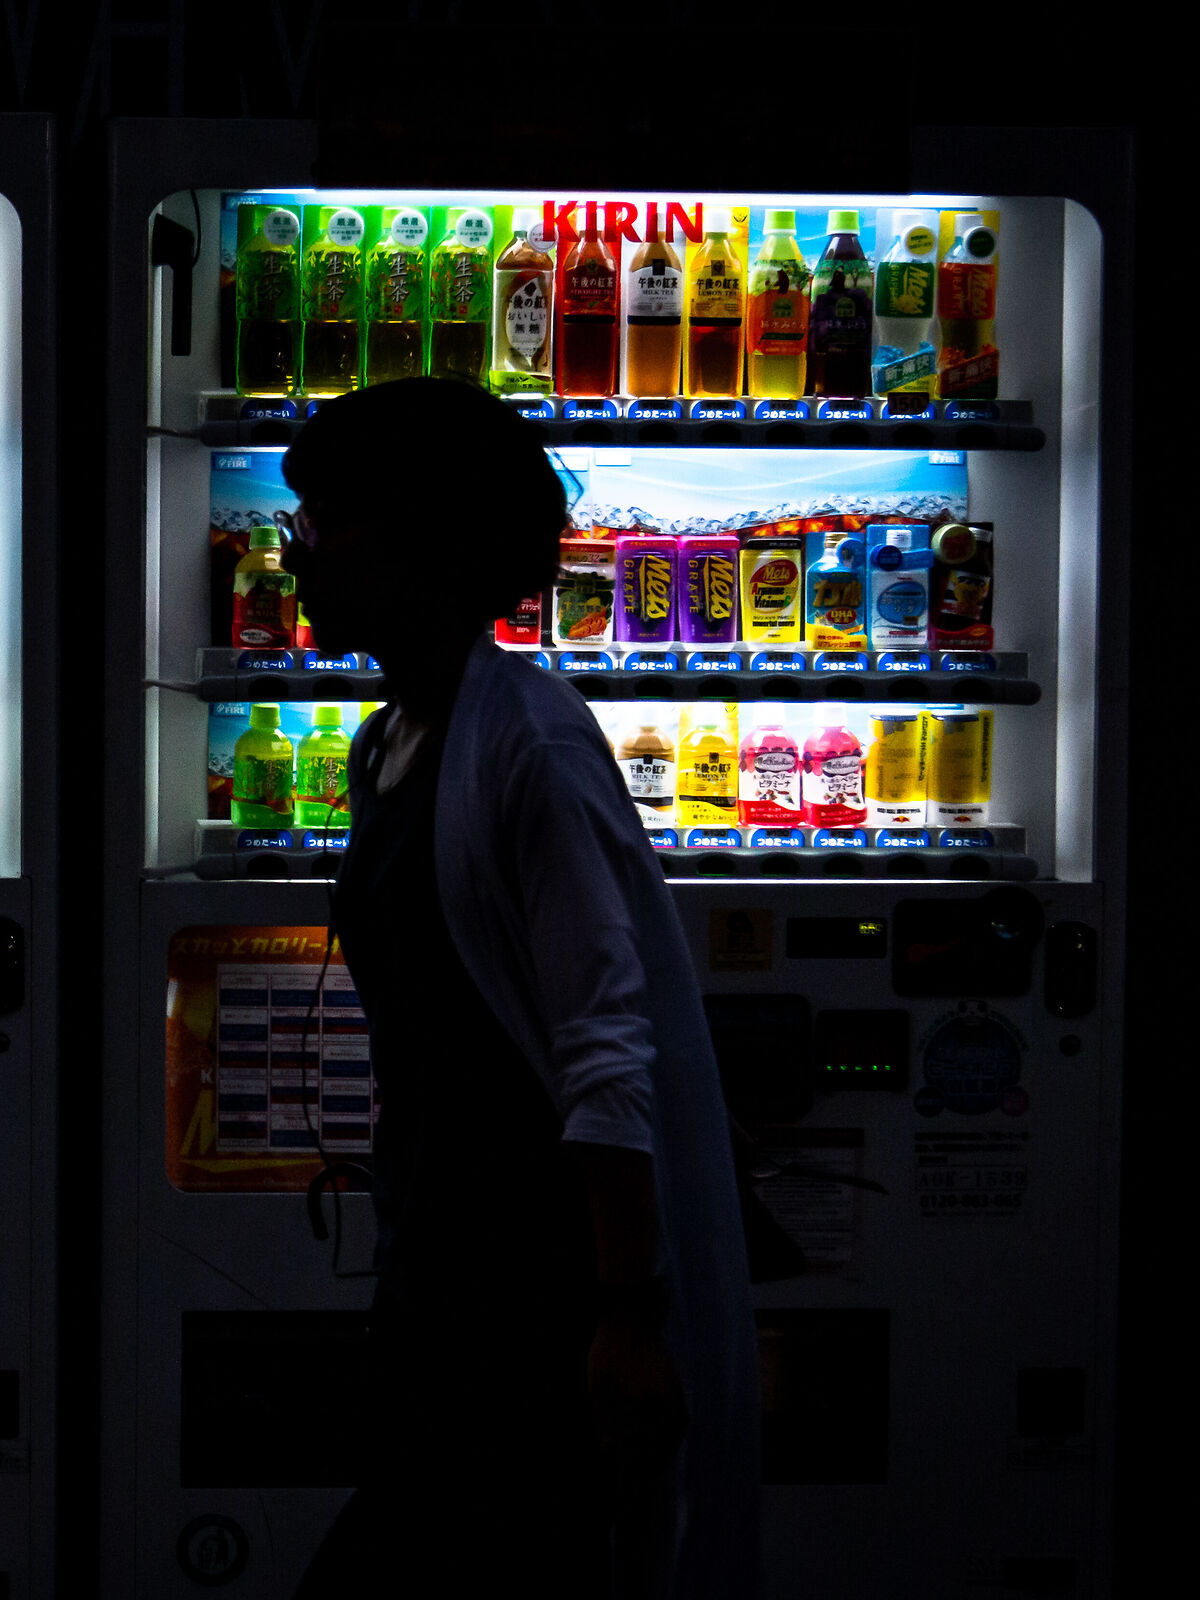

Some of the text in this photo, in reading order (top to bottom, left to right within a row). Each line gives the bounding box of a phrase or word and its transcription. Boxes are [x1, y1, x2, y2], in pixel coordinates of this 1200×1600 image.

[543, 200, 703, 243] KIRIN
[326, 255, 345, 303] 生茶
[389, 255, 409, 303] 生茶
[453, 255, 474, 303] 生茶
[571, 276, 614, 288] 午後の紅茶
[638, 277, 678, 288] 午後の紅茶
[696, 278, 739, 290] 午後の紅茶
[907, 265, 929, 315] Mets
[227, 459, 248, 468] FIRE
[623, 559, 635, 614] GRAPE
[646, 554, 670, 619] Mets
[687, 559, 699, 614] GRAPE
[709, 554, 734, 619] Mets
[763, 565, 790, 581] Mets
[830, 610, 853, 618] DHA
[224, 706, 245, 714] FIRE
[325, 759, 339, 789] 生茶
